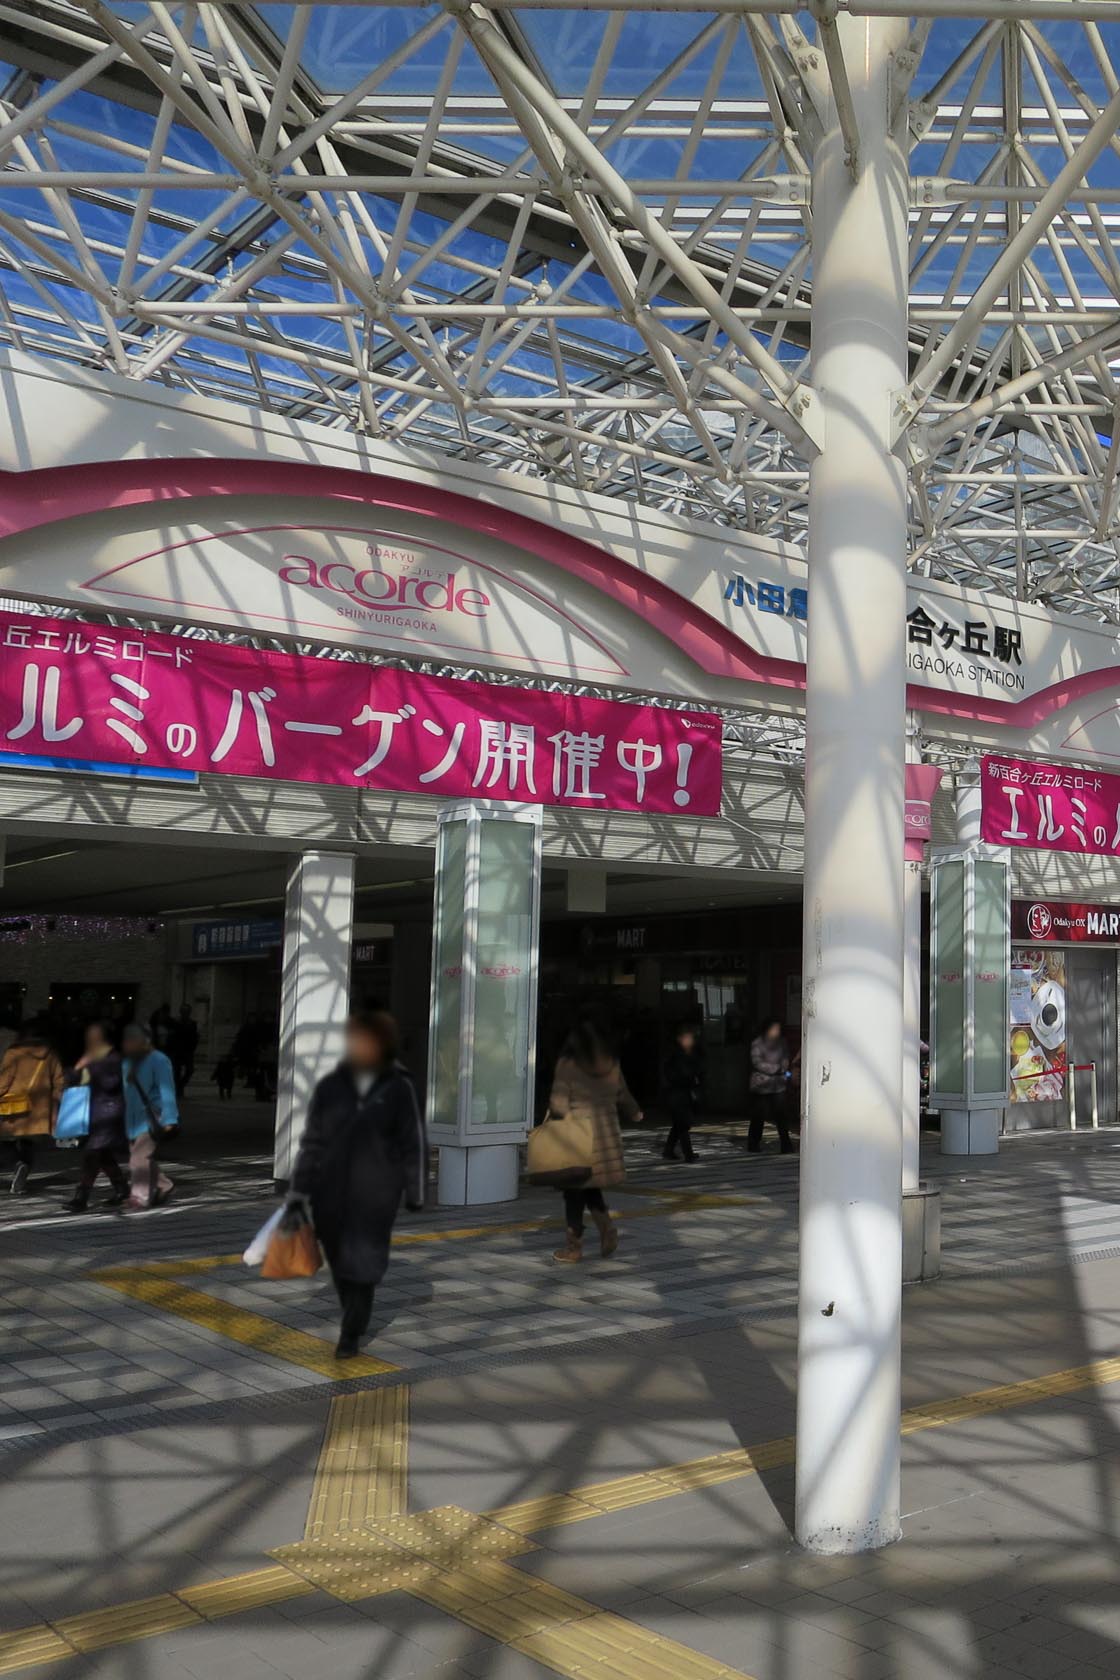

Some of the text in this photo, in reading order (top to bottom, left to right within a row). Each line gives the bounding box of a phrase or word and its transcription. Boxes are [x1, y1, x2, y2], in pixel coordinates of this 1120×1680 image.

[366, 546, 415, 564] ODAKYU
[278, 554, 491, 617] acorde
[336, 606, 438, 633] SHINYURIGAOKA
[905, 652, 1025, 690] IGAOKA STATION
[987, 762, 1102, 792] 新百合ヶ丘エルミロード
[1053, 917, 1075, 930] Odakyu
[1075, 918, 1086, 928] OX
[616, 928, 647, 949] MART
